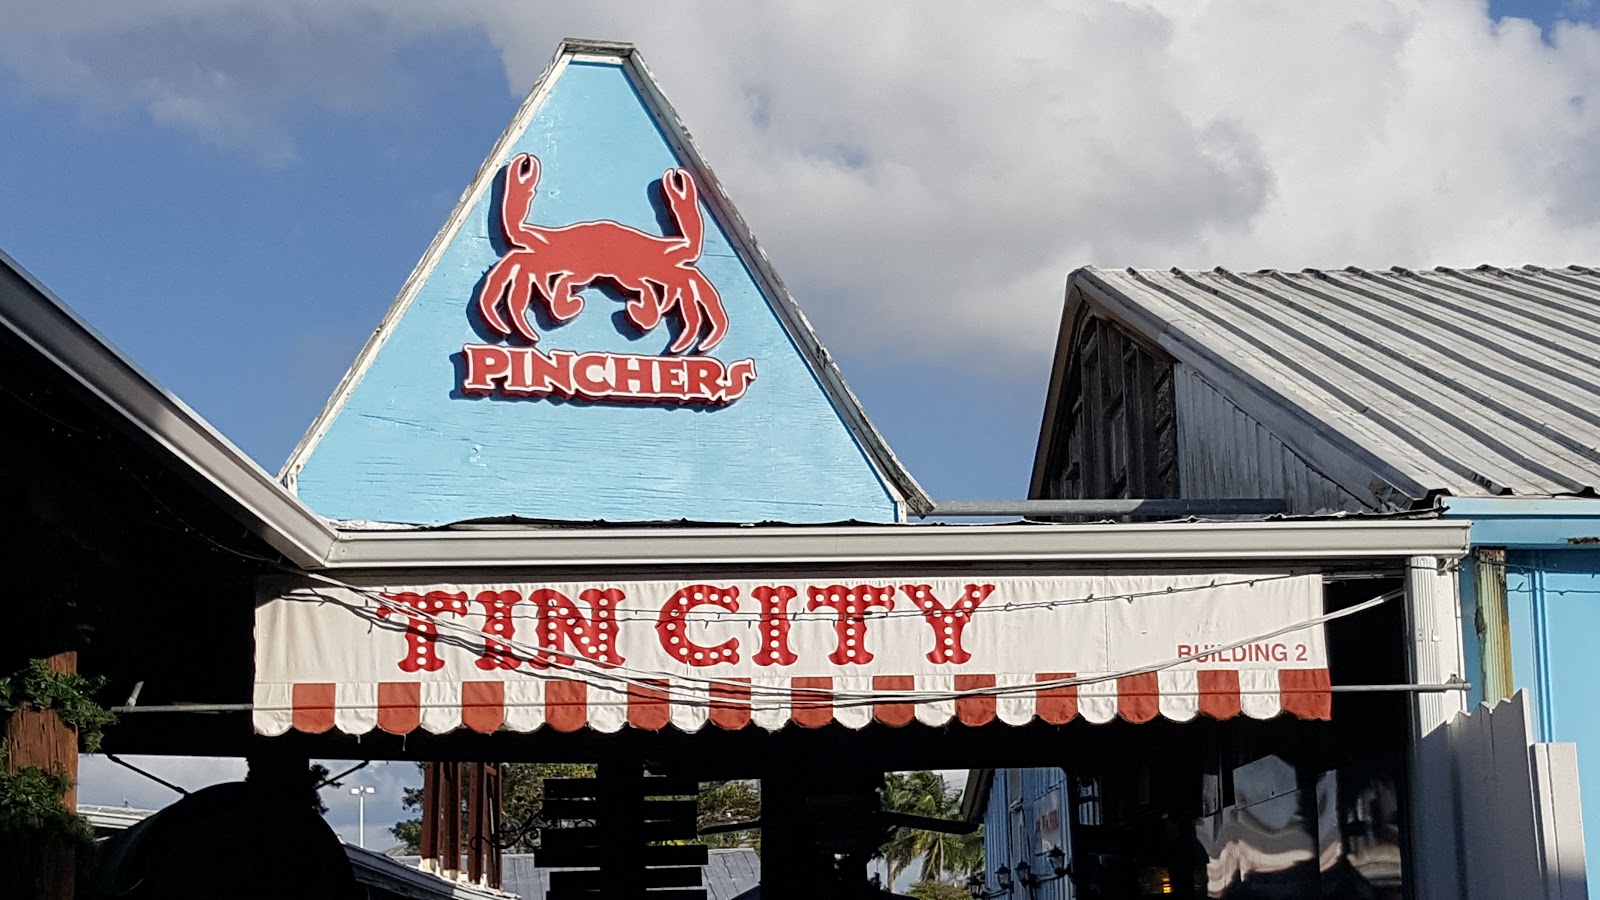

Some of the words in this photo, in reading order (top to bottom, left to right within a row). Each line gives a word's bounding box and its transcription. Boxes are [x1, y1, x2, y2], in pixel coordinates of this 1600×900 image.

[463, 344, 757, 400] PINCHERS
[376, 587, 627, 673] TIN
[655, 583, 996, 667] CITY
[1177, 643, 1288, 663] BUILDING
[1294, 643, 1308, 662] 2
